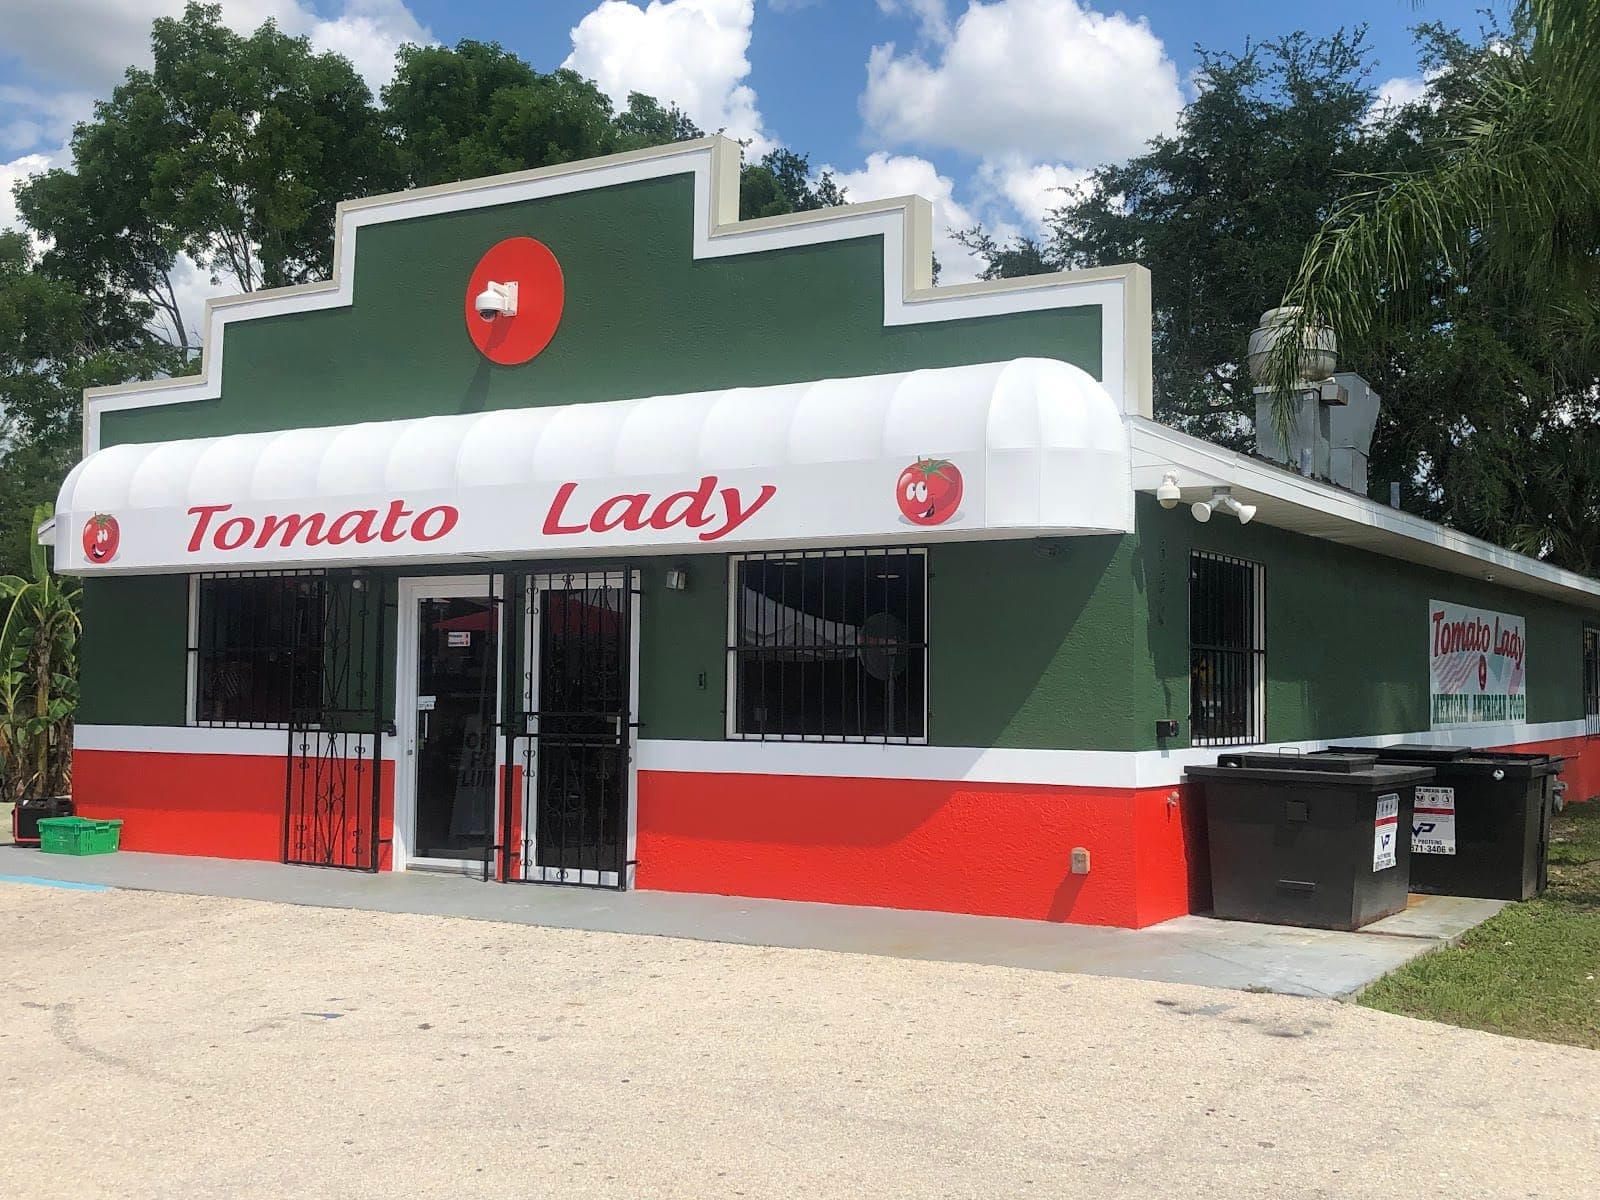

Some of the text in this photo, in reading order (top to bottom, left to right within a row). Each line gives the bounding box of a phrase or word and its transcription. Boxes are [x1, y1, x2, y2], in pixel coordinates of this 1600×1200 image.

[187, 475, 777, 552] Tomato Lady
[1432, 611, 1525, 670] Tomato Lady
[1432, 694, 1525, 724] MEXICAN AMERICAN FOOD
